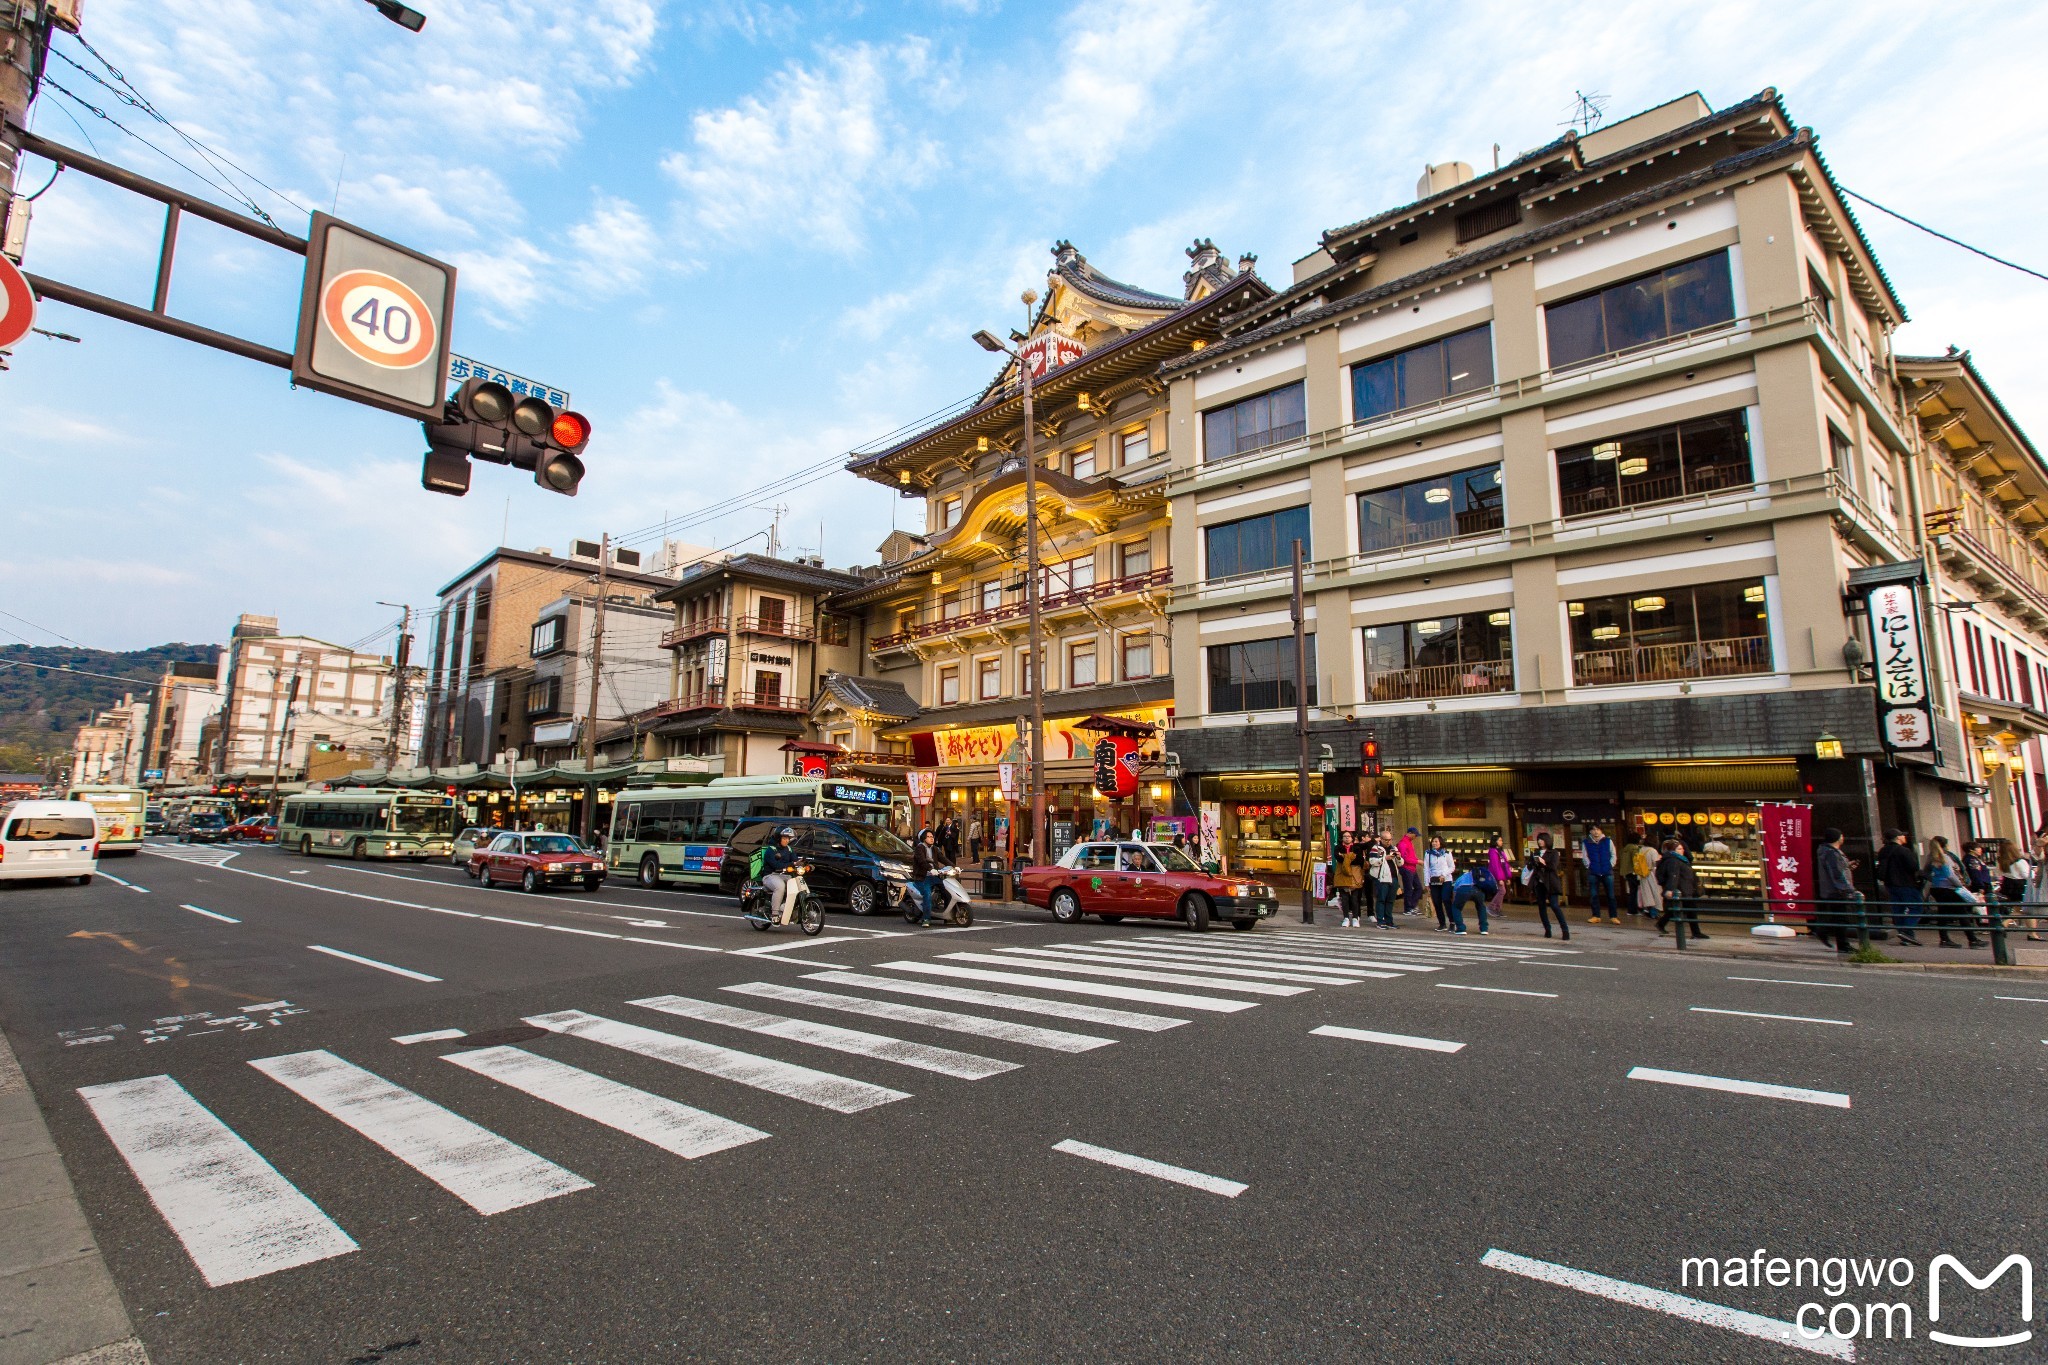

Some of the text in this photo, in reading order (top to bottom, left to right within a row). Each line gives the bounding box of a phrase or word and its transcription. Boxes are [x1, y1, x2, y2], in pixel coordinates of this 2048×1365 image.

[351, 297, 412, 345] 40
[1884, 591, 1899, 614] 総本家
[1880, 614, 1919, 698] にしんそば
[1894, 713, 1919, 742] 松葉
[947, 729, 1003, 762] 都をどり
[1095, 739, 1118, 792] 南座
[866, 789, 878, 801] 46
[1779, 821, 1787, 852] にしんそば
